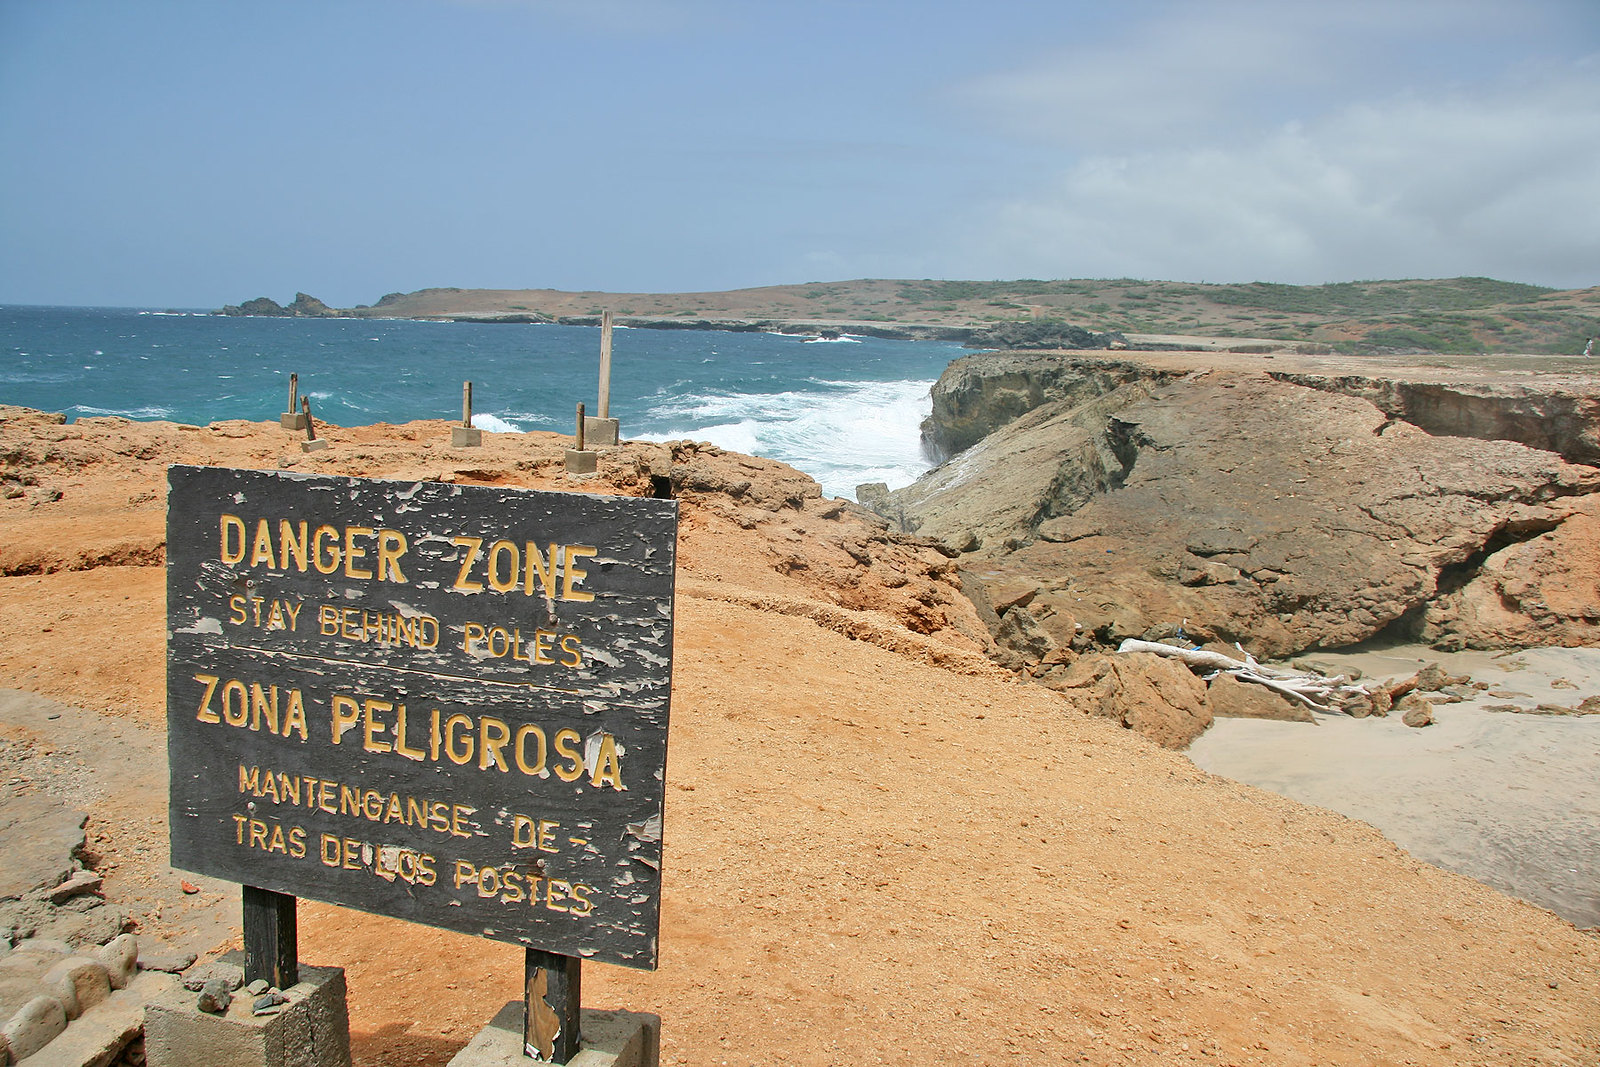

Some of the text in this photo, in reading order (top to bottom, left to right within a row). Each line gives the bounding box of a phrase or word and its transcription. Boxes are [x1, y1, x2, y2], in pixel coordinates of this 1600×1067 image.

[220, 514, 598, 602] DANGER ZONE
[229, 594, 582, 668] STAY BEHIND POLES
[195, 674, 624, 790] ZONA PELIGROSA
[239, 765, 473, 838] MANTENGANSE
[233, 814, 593, 916] TRAS DE LOS POSTES
